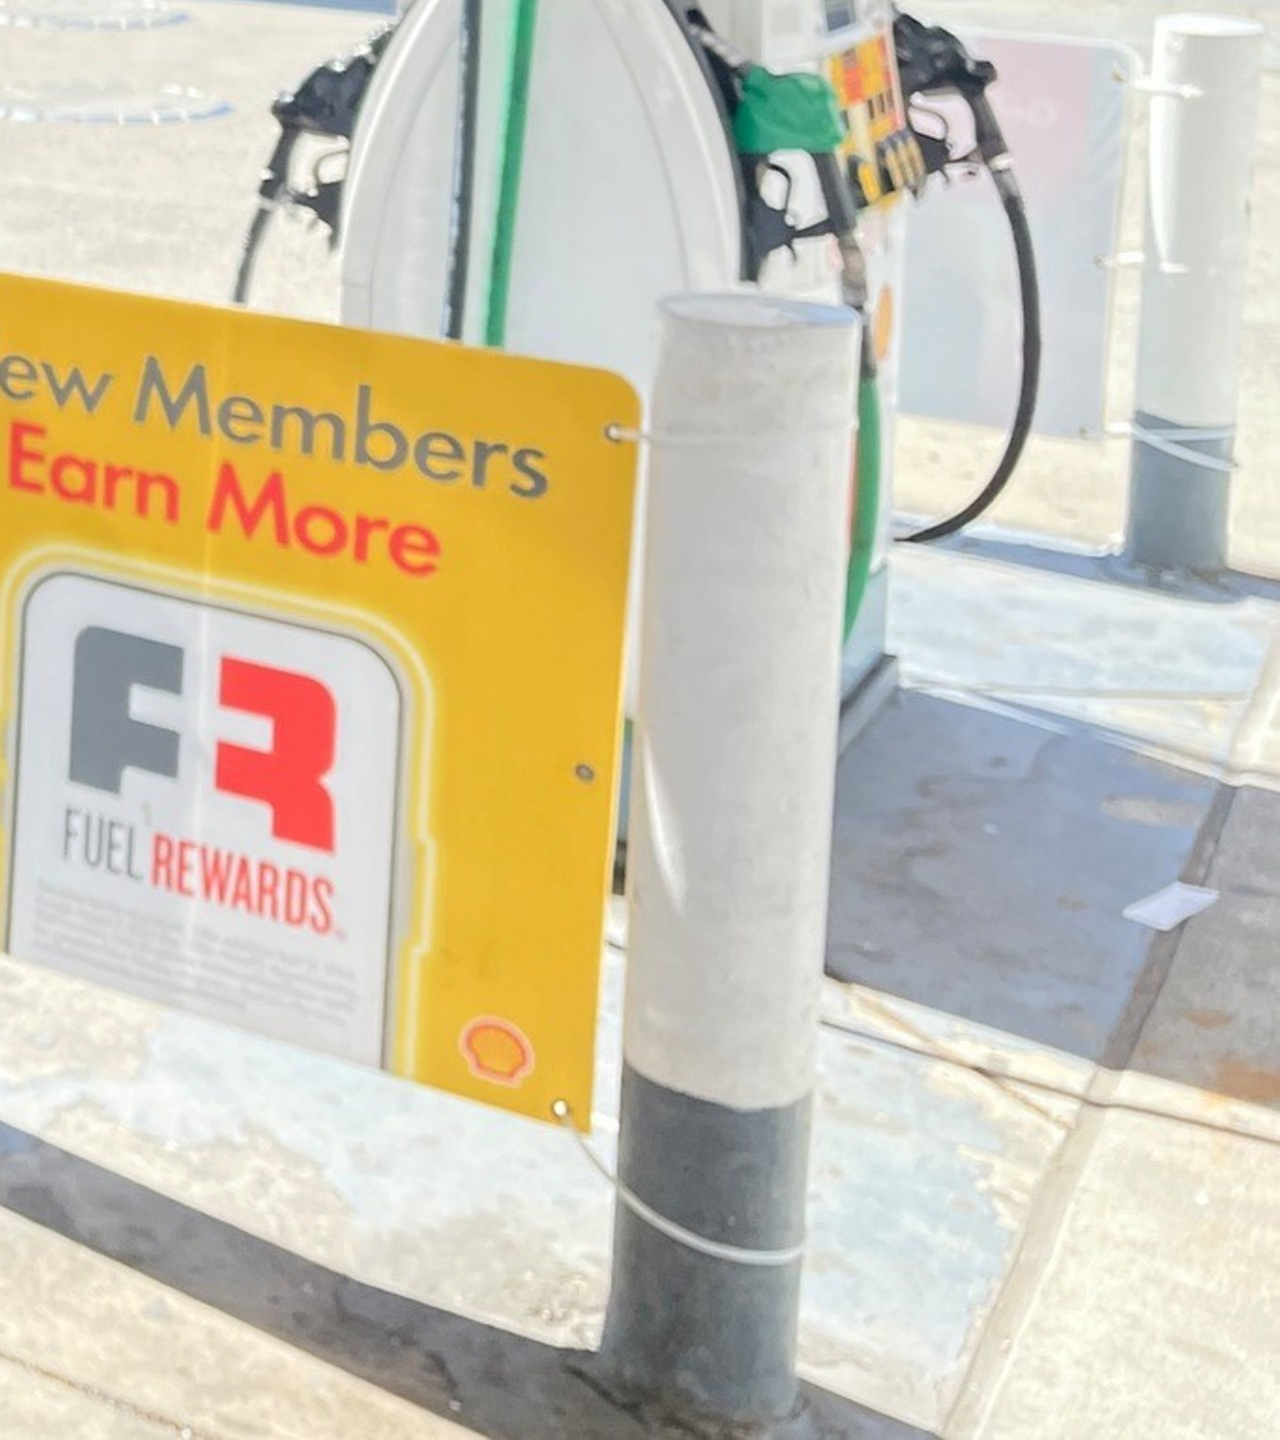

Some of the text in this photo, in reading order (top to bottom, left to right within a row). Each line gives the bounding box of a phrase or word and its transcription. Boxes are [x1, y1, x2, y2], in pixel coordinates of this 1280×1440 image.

[6, 418, 442, 579] Earn More
[132, 355, 550, 501] Members
[62, 806, 335, 935] FUEL REWARDS
